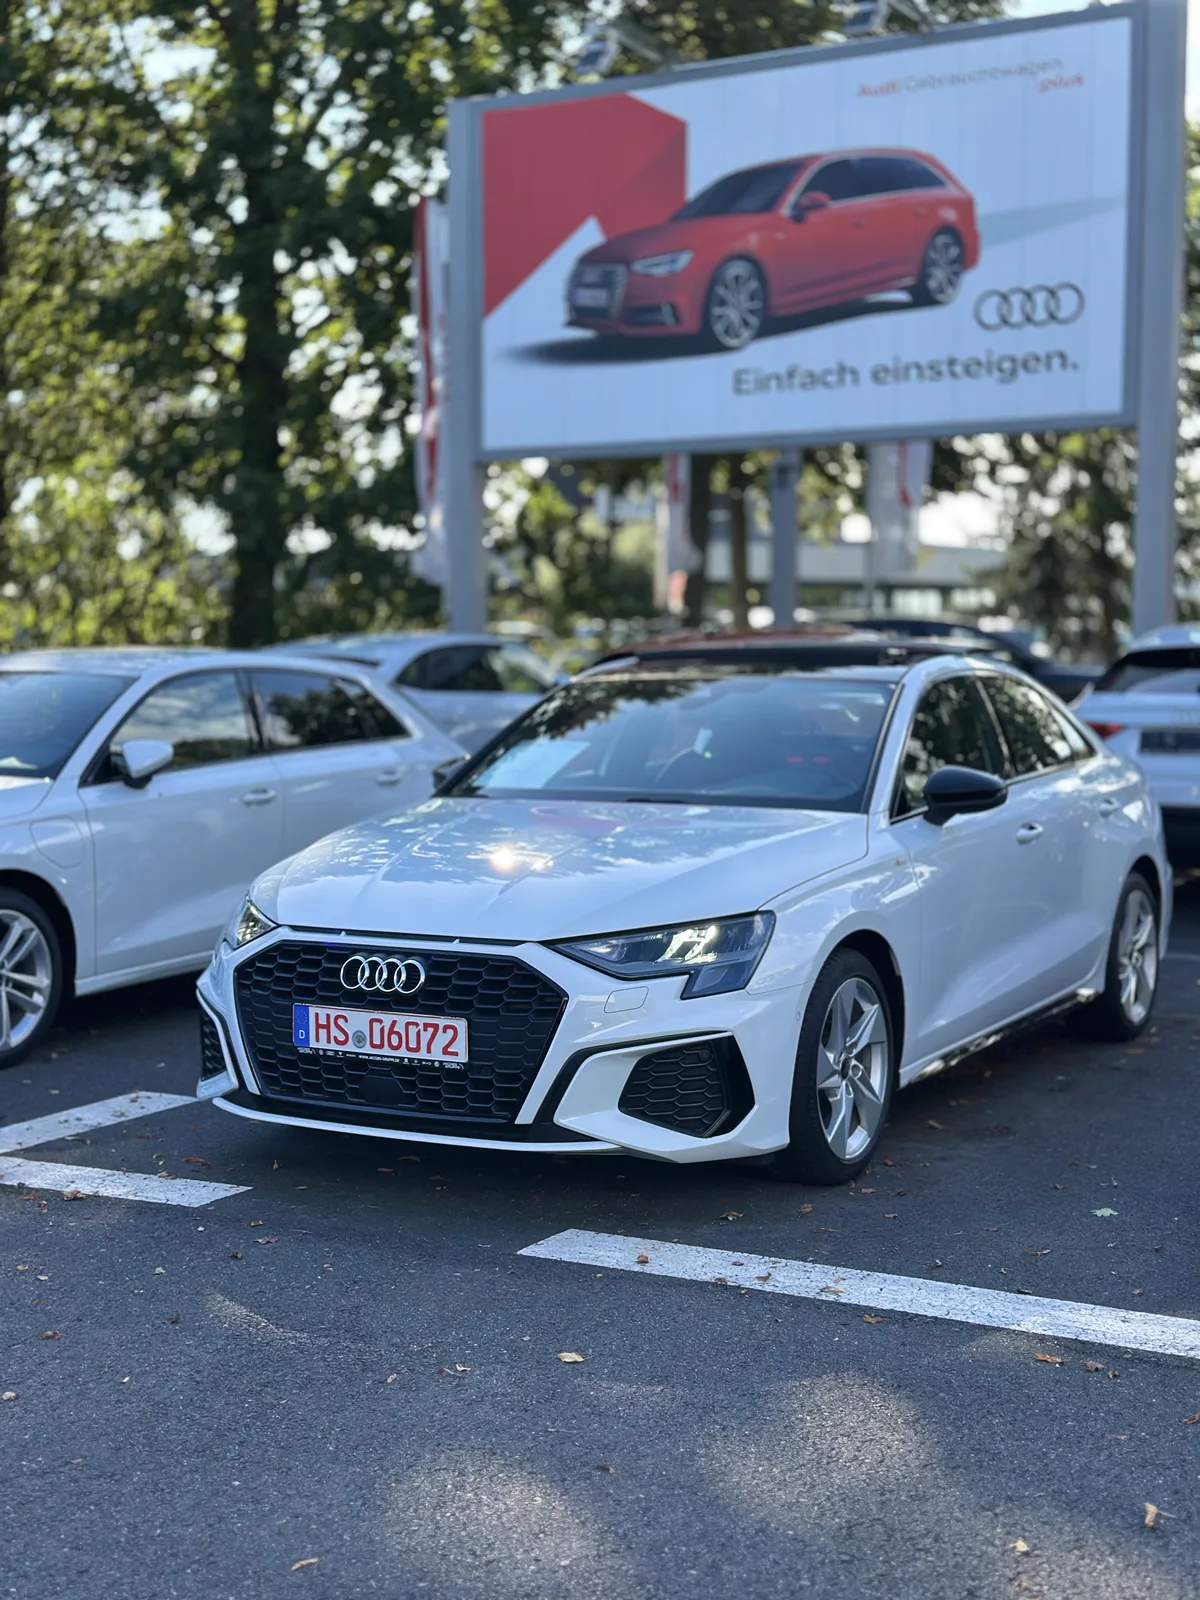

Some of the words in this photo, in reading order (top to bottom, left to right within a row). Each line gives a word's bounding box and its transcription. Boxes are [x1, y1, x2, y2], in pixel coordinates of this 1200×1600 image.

[732, 360, 860, 396] Einfach
[870, 348, 1080, 385] einsteigen.
[299, 1030, 306, 1039] D
[314, 1012, 350, 1046] HS
[368, 1017, 459, 1057] 06072
